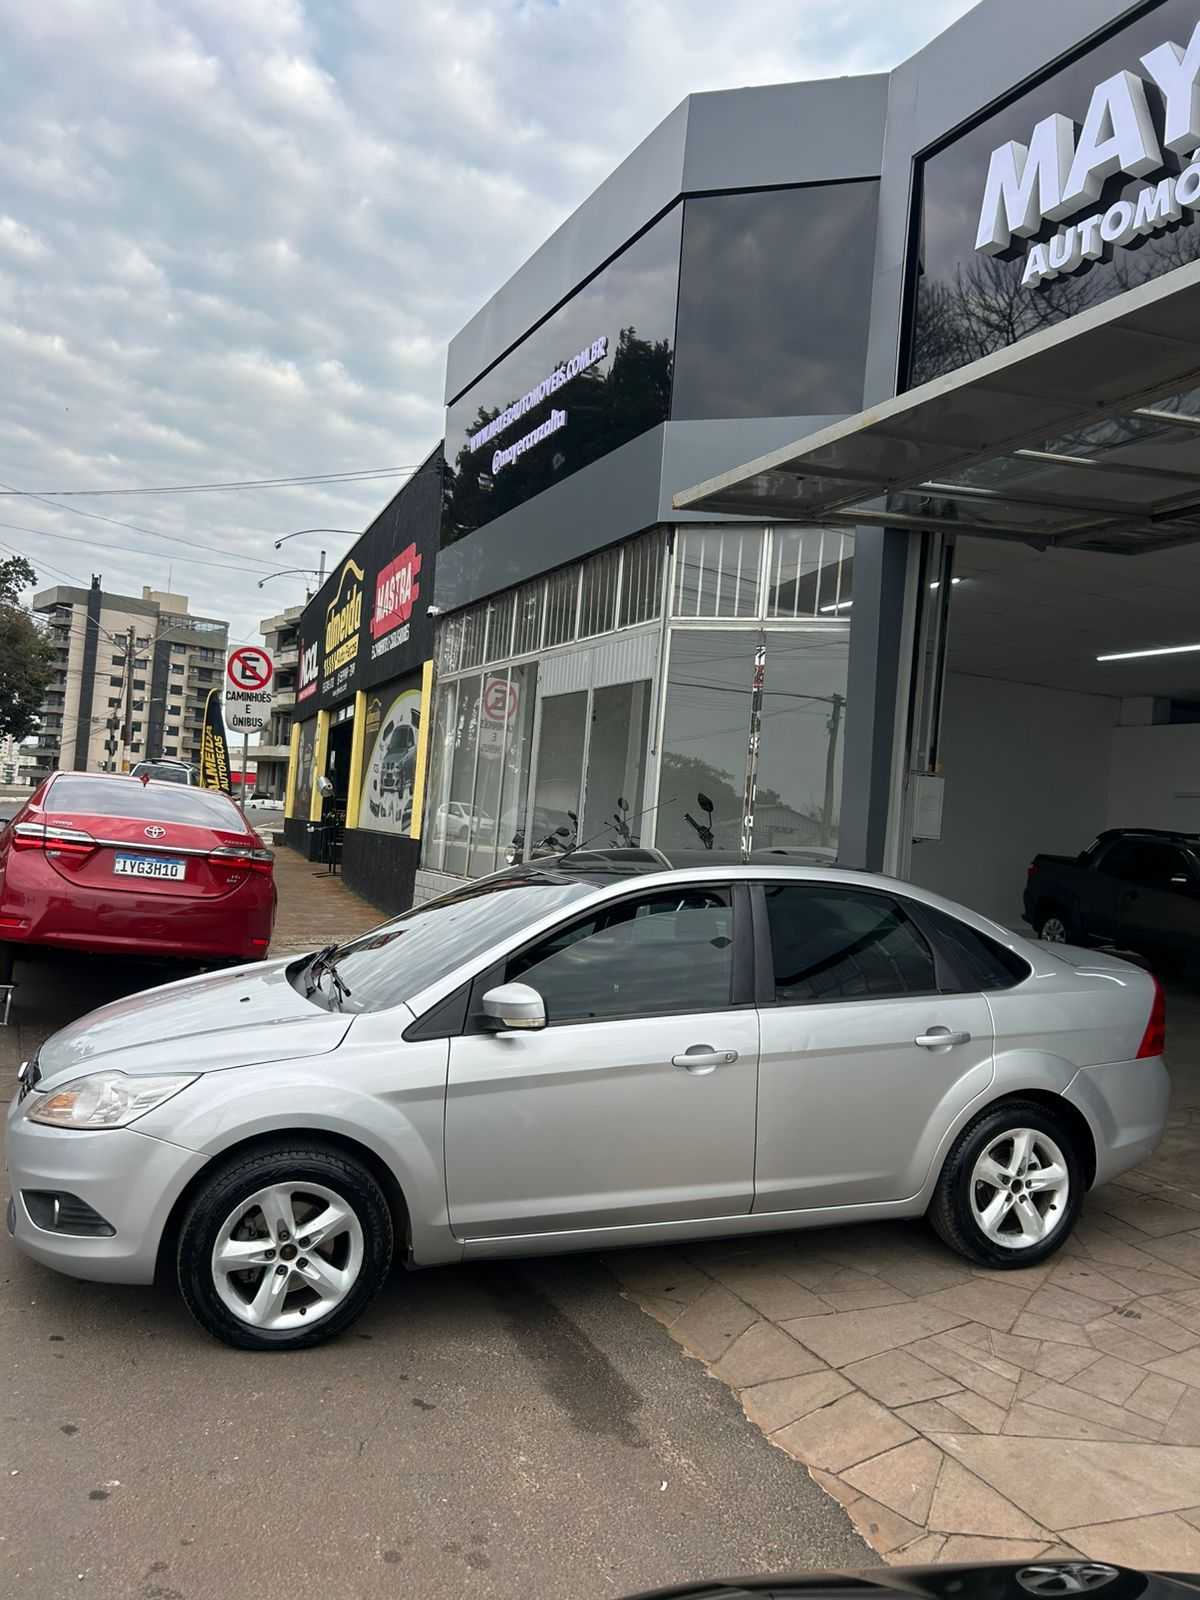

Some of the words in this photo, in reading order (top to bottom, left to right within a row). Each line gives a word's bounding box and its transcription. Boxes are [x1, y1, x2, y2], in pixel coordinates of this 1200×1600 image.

[975, 19, 1200, 252] MAY
[376, 563, 412, 623] MASTRA
[246, 704, 251, 713] E
[232, 714, 263, 727] ÔNIBUS
[120, 860, 178, 877] IYG3H10
